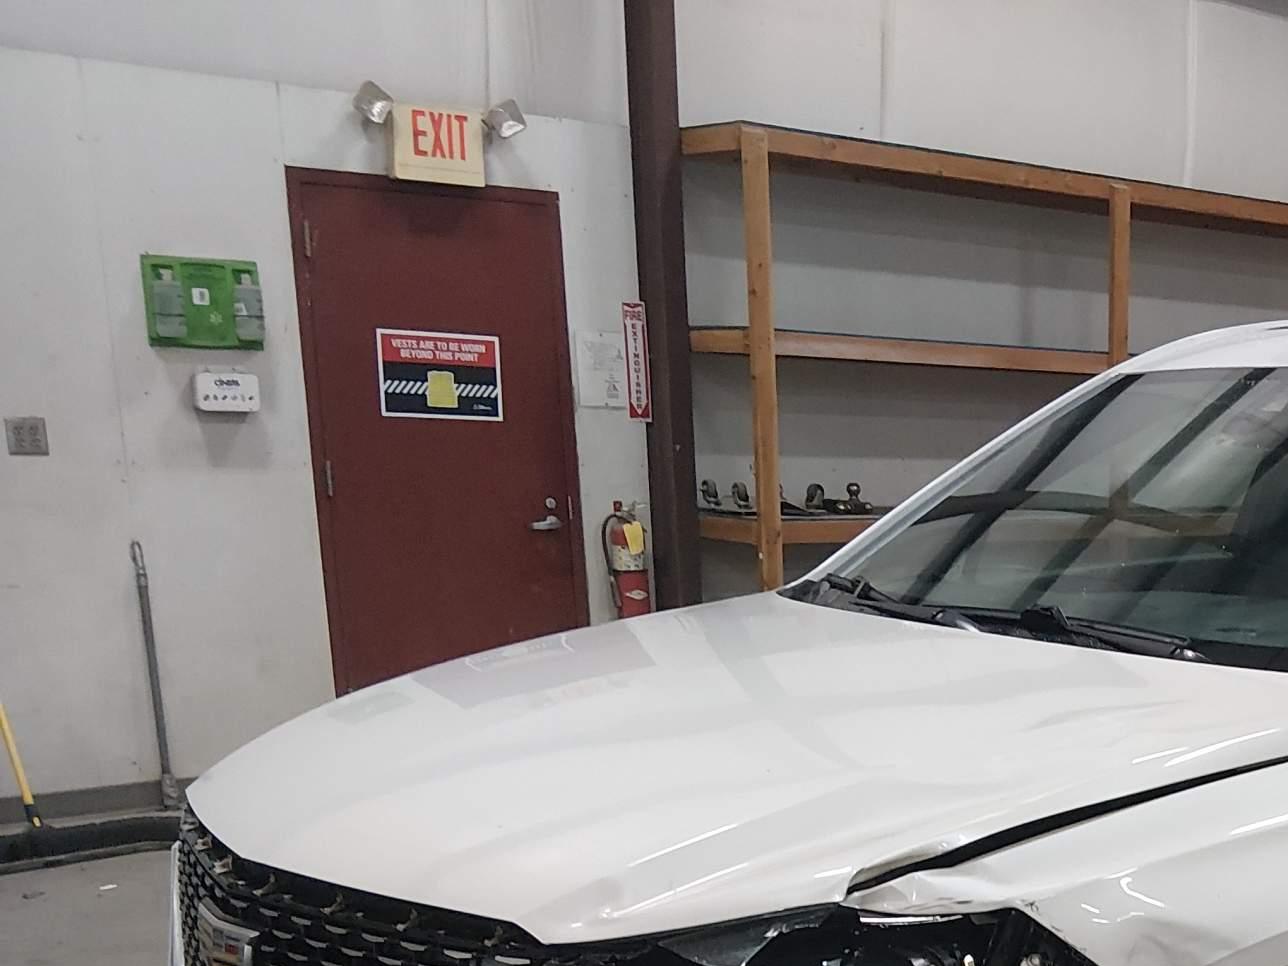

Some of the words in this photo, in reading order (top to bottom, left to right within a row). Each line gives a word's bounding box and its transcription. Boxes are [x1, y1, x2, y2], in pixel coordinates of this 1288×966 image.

[411, 109, 468, 161] EXIT
[624, 310, 642, 321] FIRE
[391, 338, 417, 348] VESTS
[419, 340, 435, 349] ARE
[436, 341, 448, 350] TO
[448, 342, 460, 351] BE
[460, 343, 486, 353] WORN
[400, 348, 433, 359] BEYOND
[435, 350, 454, 360] THIS
[455, 352, 479, 362] POINT
[631, 324, 642, 408] EXTINGUISHER
